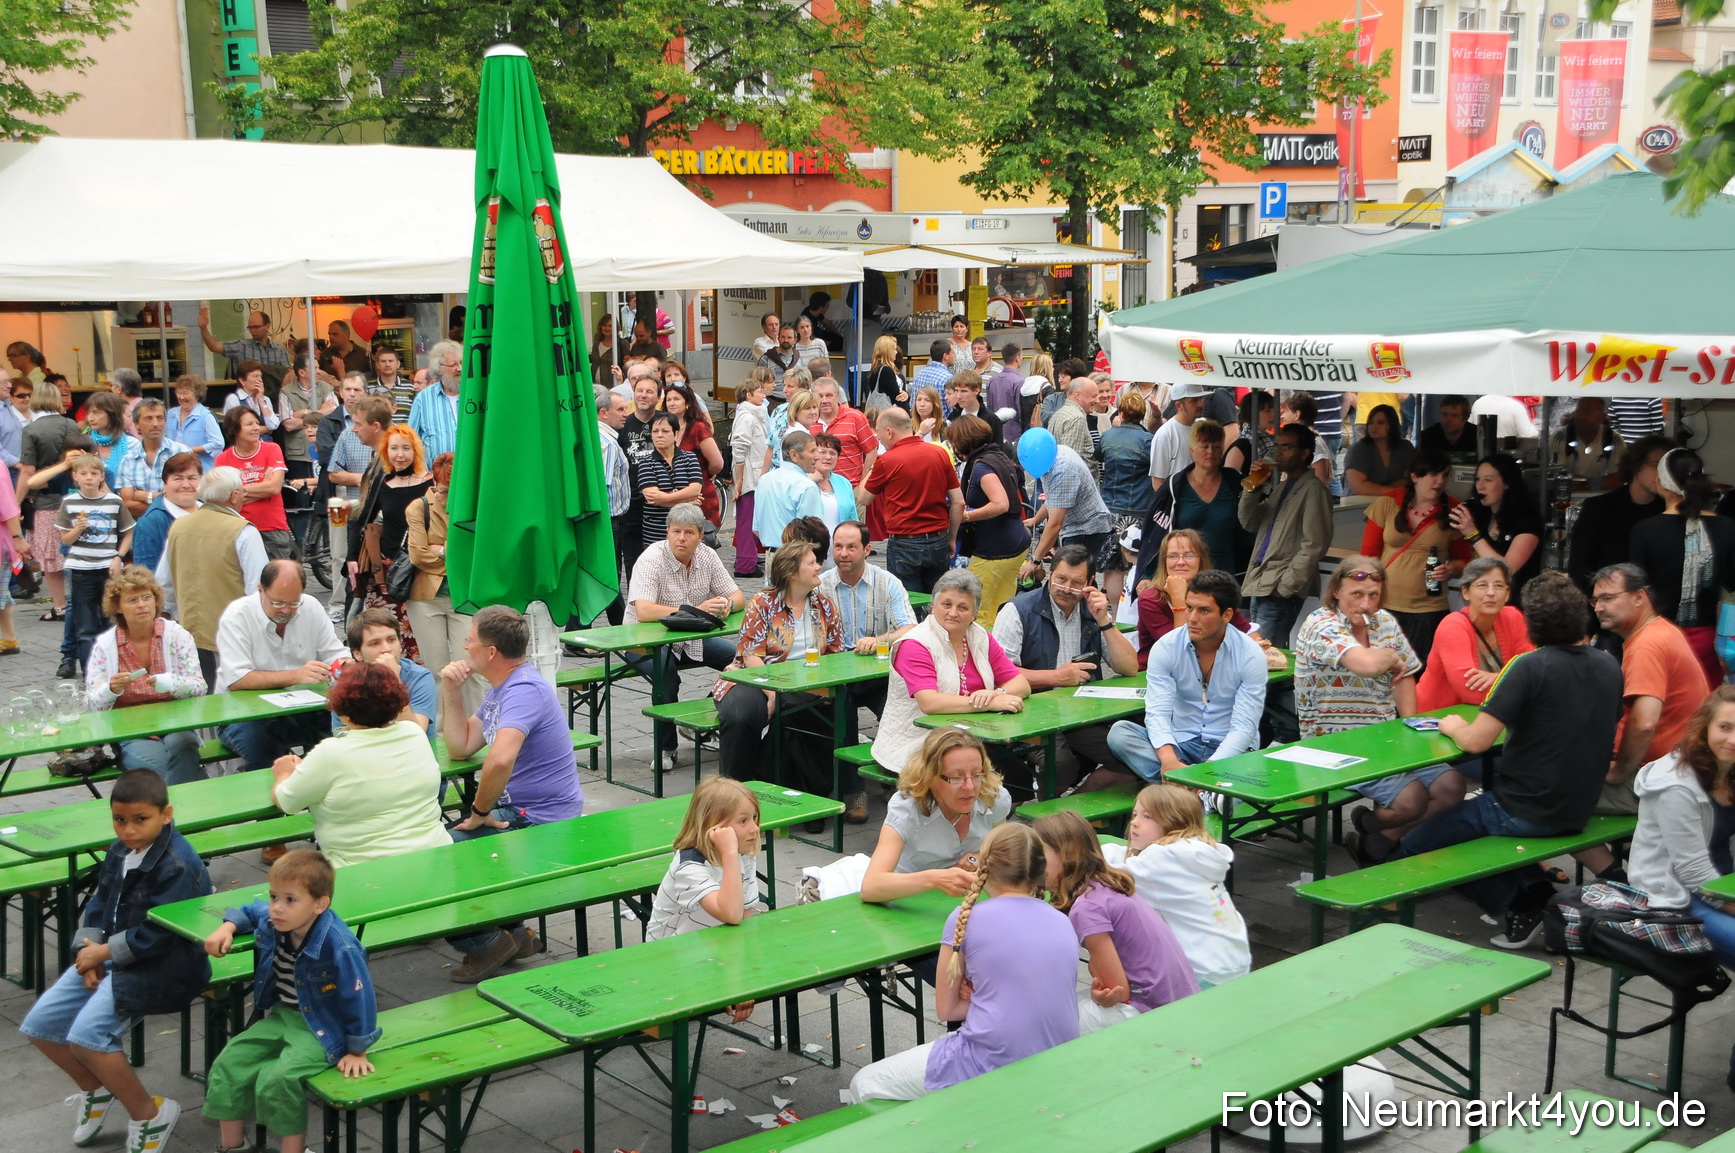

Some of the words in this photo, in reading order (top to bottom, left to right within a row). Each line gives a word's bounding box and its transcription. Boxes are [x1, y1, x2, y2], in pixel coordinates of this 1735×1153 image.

[1452, 48, 1472, 59] Wir
[1474, 47, 1503, 60] feiern
[1563, 55, 1585, 66] Wir
[1588, 54, 1623, 66] feiern
[1456, 82, 1490, 92] IMMER
[1571, 87, 1610, 97] IMMER
[1455, 93, 1490, 103] WIEDER
[1569, 97, 1612, 107] WIEDER
[1456, 103, 1487, 117] NEU
[1571, 107, 1608, 121] NEU
[1571, 121, 1607, 131] MARKT
[1400, 137, 1427, 150] MATT
[1646, 133, 1670, 146] C&A
[653, 149, 699, 175] DER
[704, 145, 788, 175] BÄCKER
[1402, 151, 1422, 161] optik
[1266, 186, 1282, 215] P
[743, 218, 788, 234] Gutmann
[1234, 338, 1334, 356] Neumarkter
[1218, 354, 1358, 382] Lammsbräu
[1373, 369, 1387, 378] SEIT
